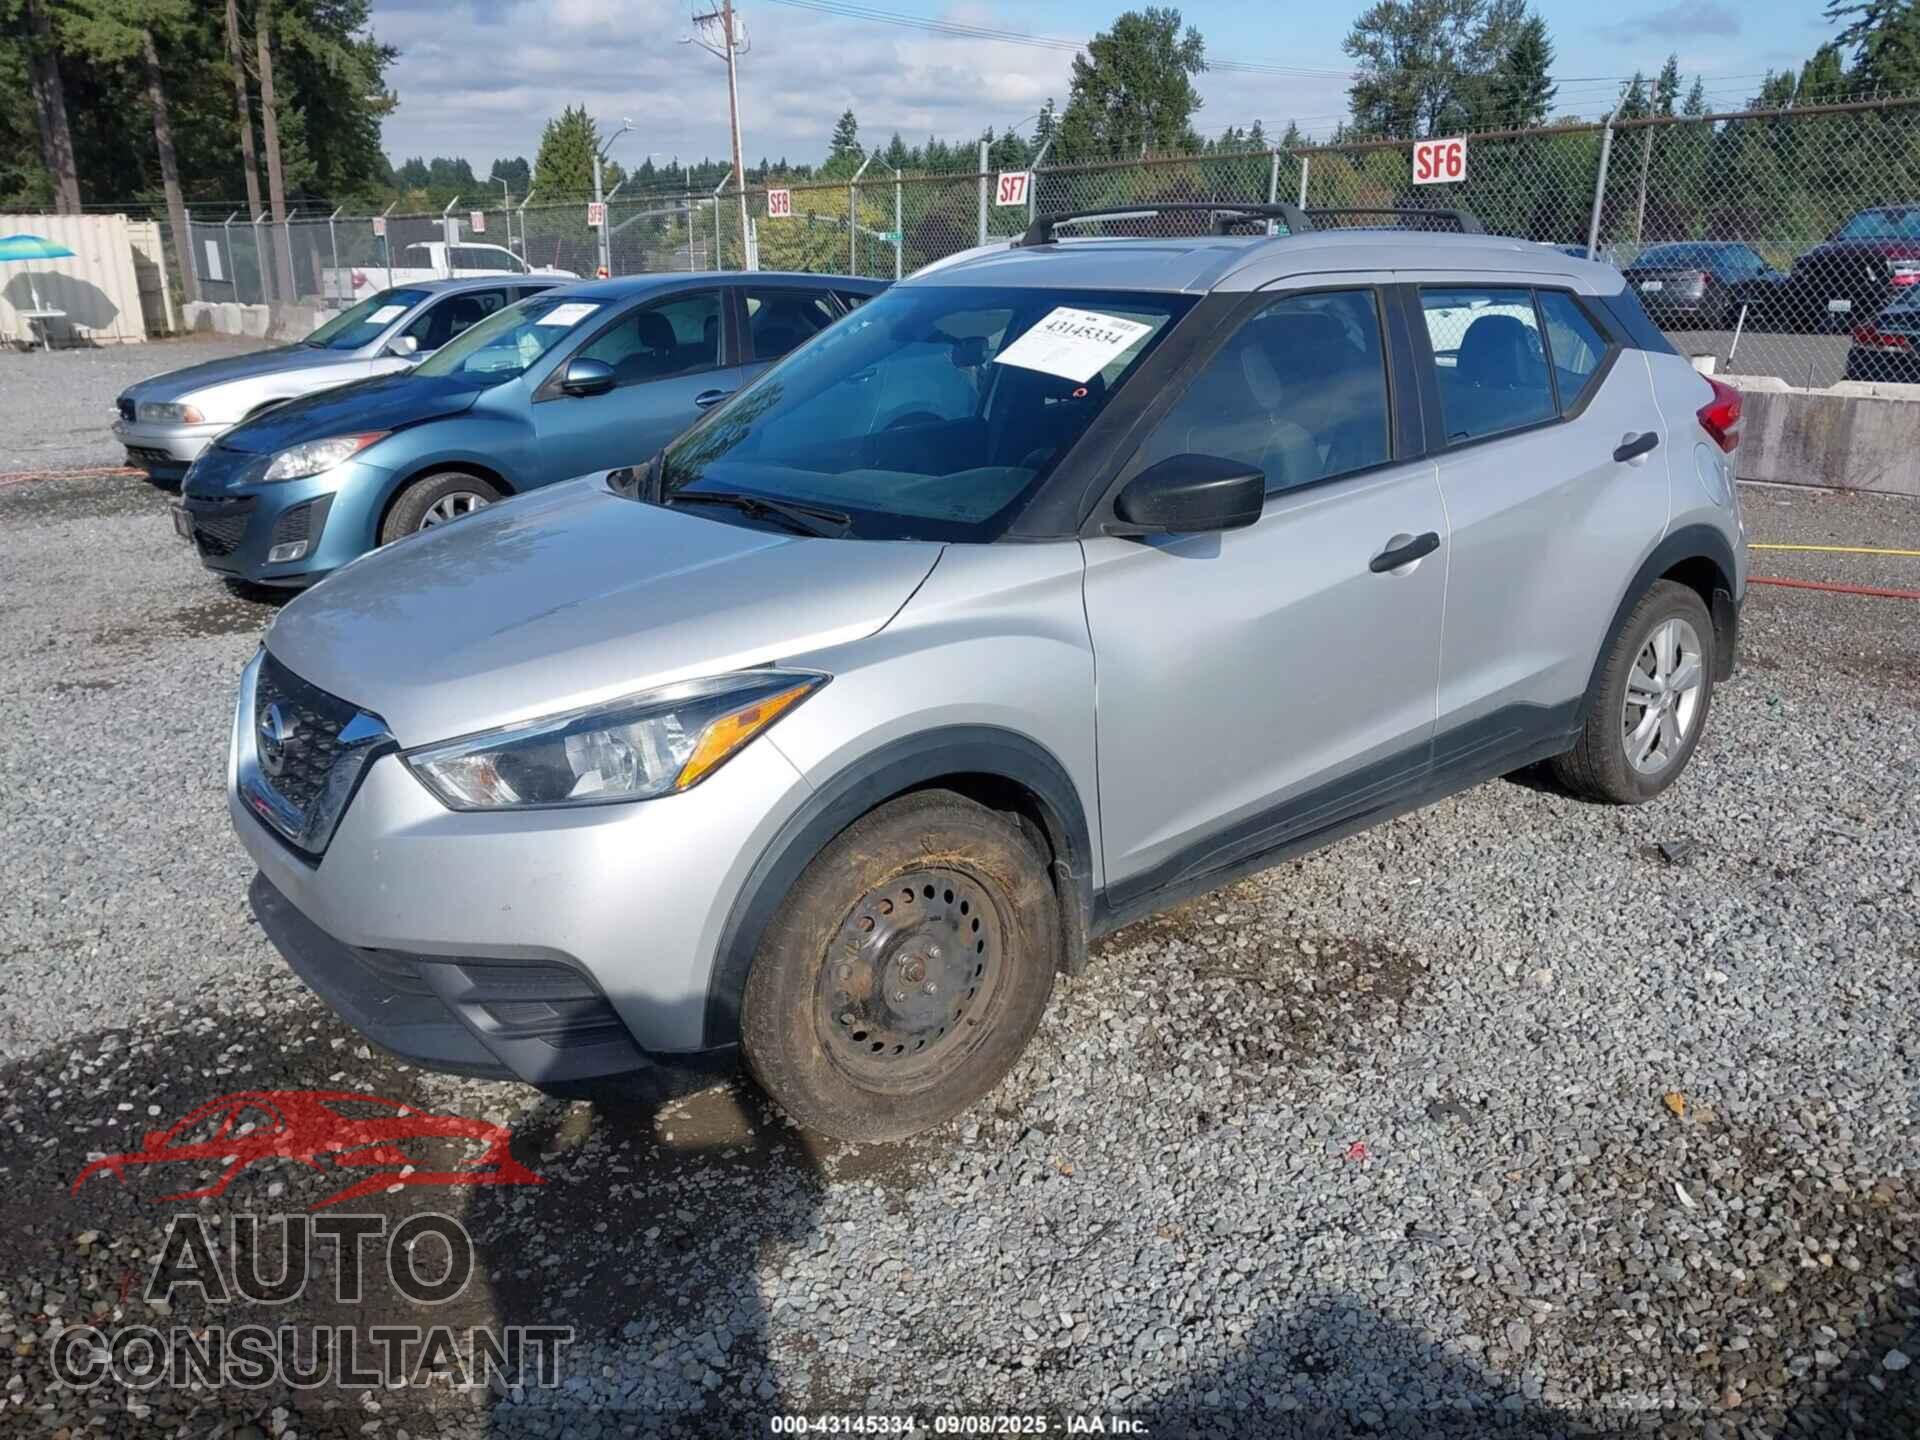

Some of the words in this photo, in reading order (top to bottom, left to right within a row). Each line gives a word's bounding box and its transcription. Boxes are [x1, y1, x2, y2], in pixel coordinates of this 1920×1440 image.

[1417, 143, 1461, 179] SF6
[1000, 176, 1025, 202] SF7
[770, 192, 788, 213] SF8
[1046, 320, 1123, 344] 43145334
